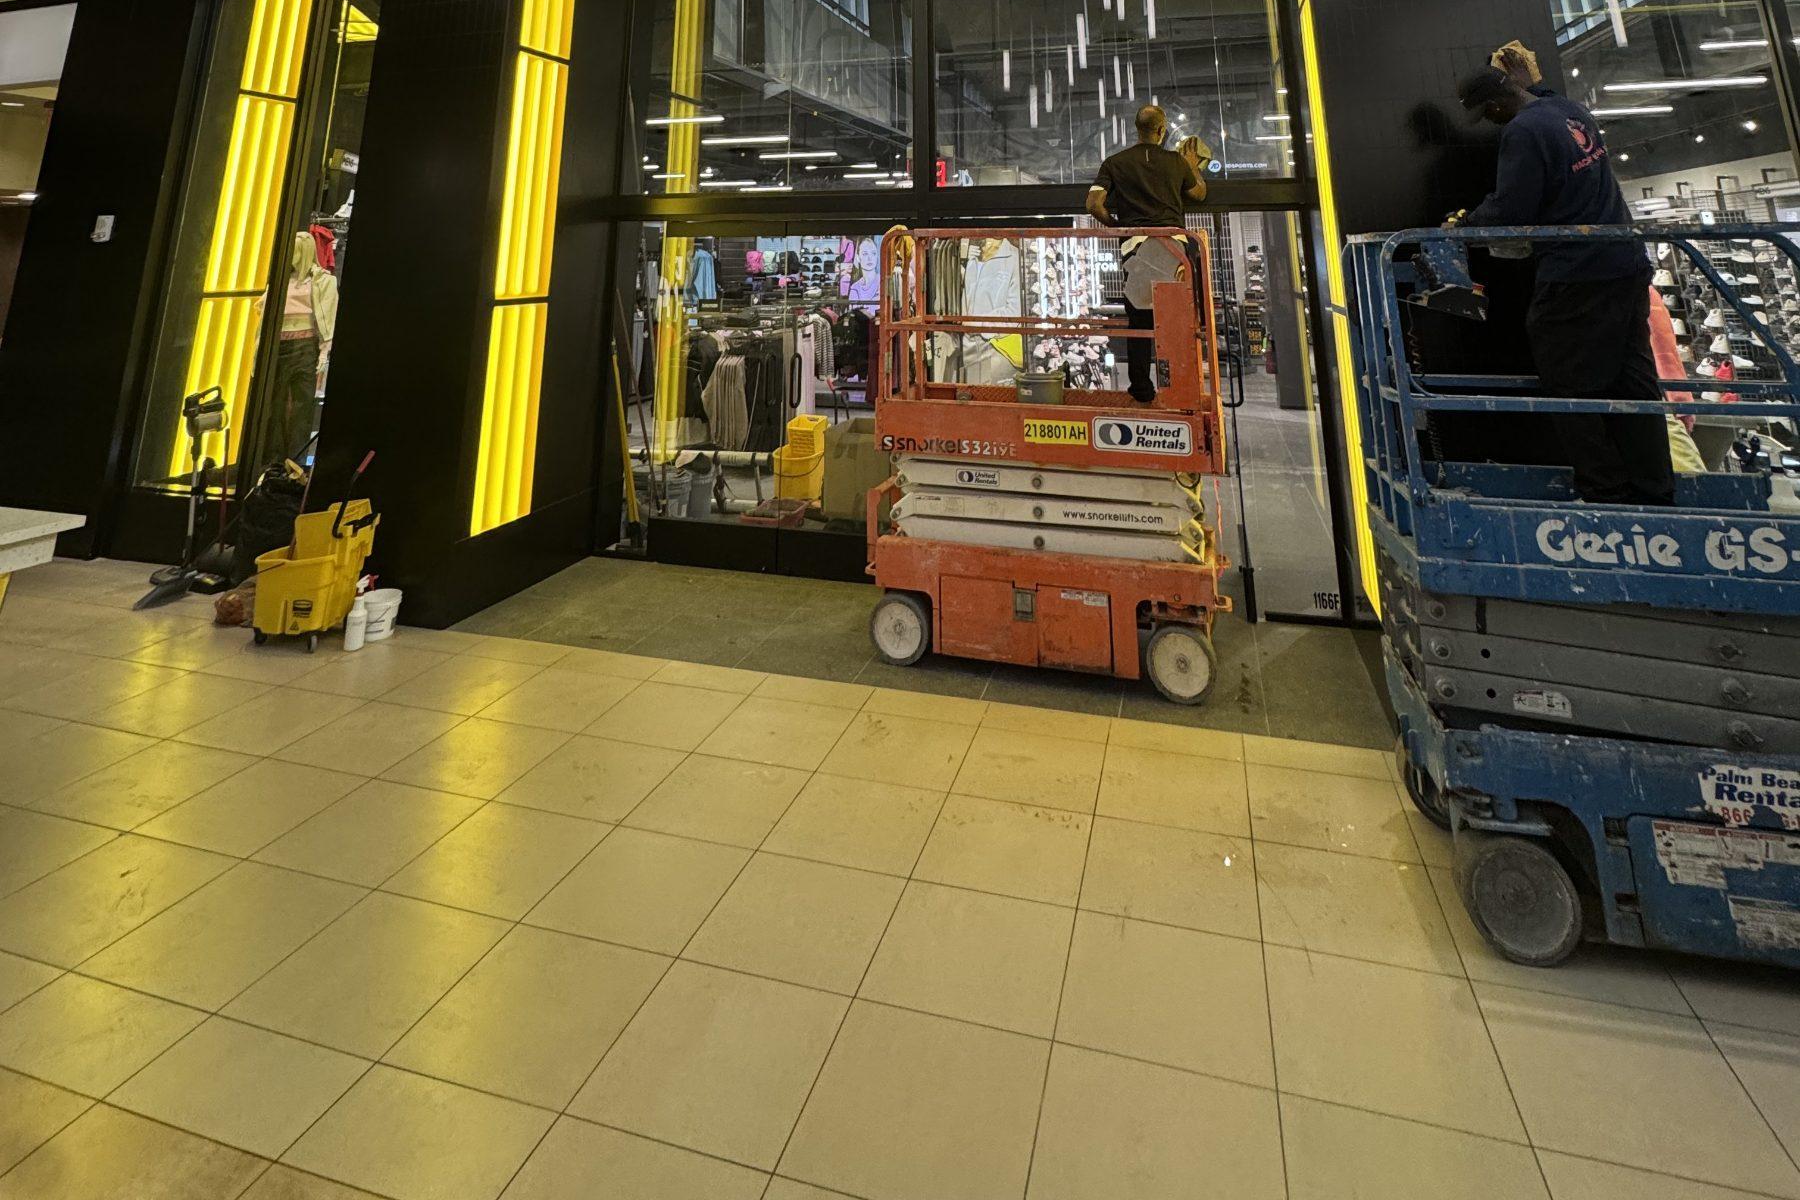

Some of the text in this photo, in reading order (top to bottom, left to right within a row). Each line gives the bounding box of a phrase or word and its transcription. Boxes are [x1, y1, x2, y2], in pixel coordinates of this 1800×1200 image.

[1024, 423, 1087, 440] 218801AH
[1135, 425, 1181, 438] United
[1135, 438, 1186, 450] Rentals
[975, 471, 996, 479] United
[1063, 509, 1163, 524] www.snorkellifts.com
[1702, 766, 1753, 785] Palm
